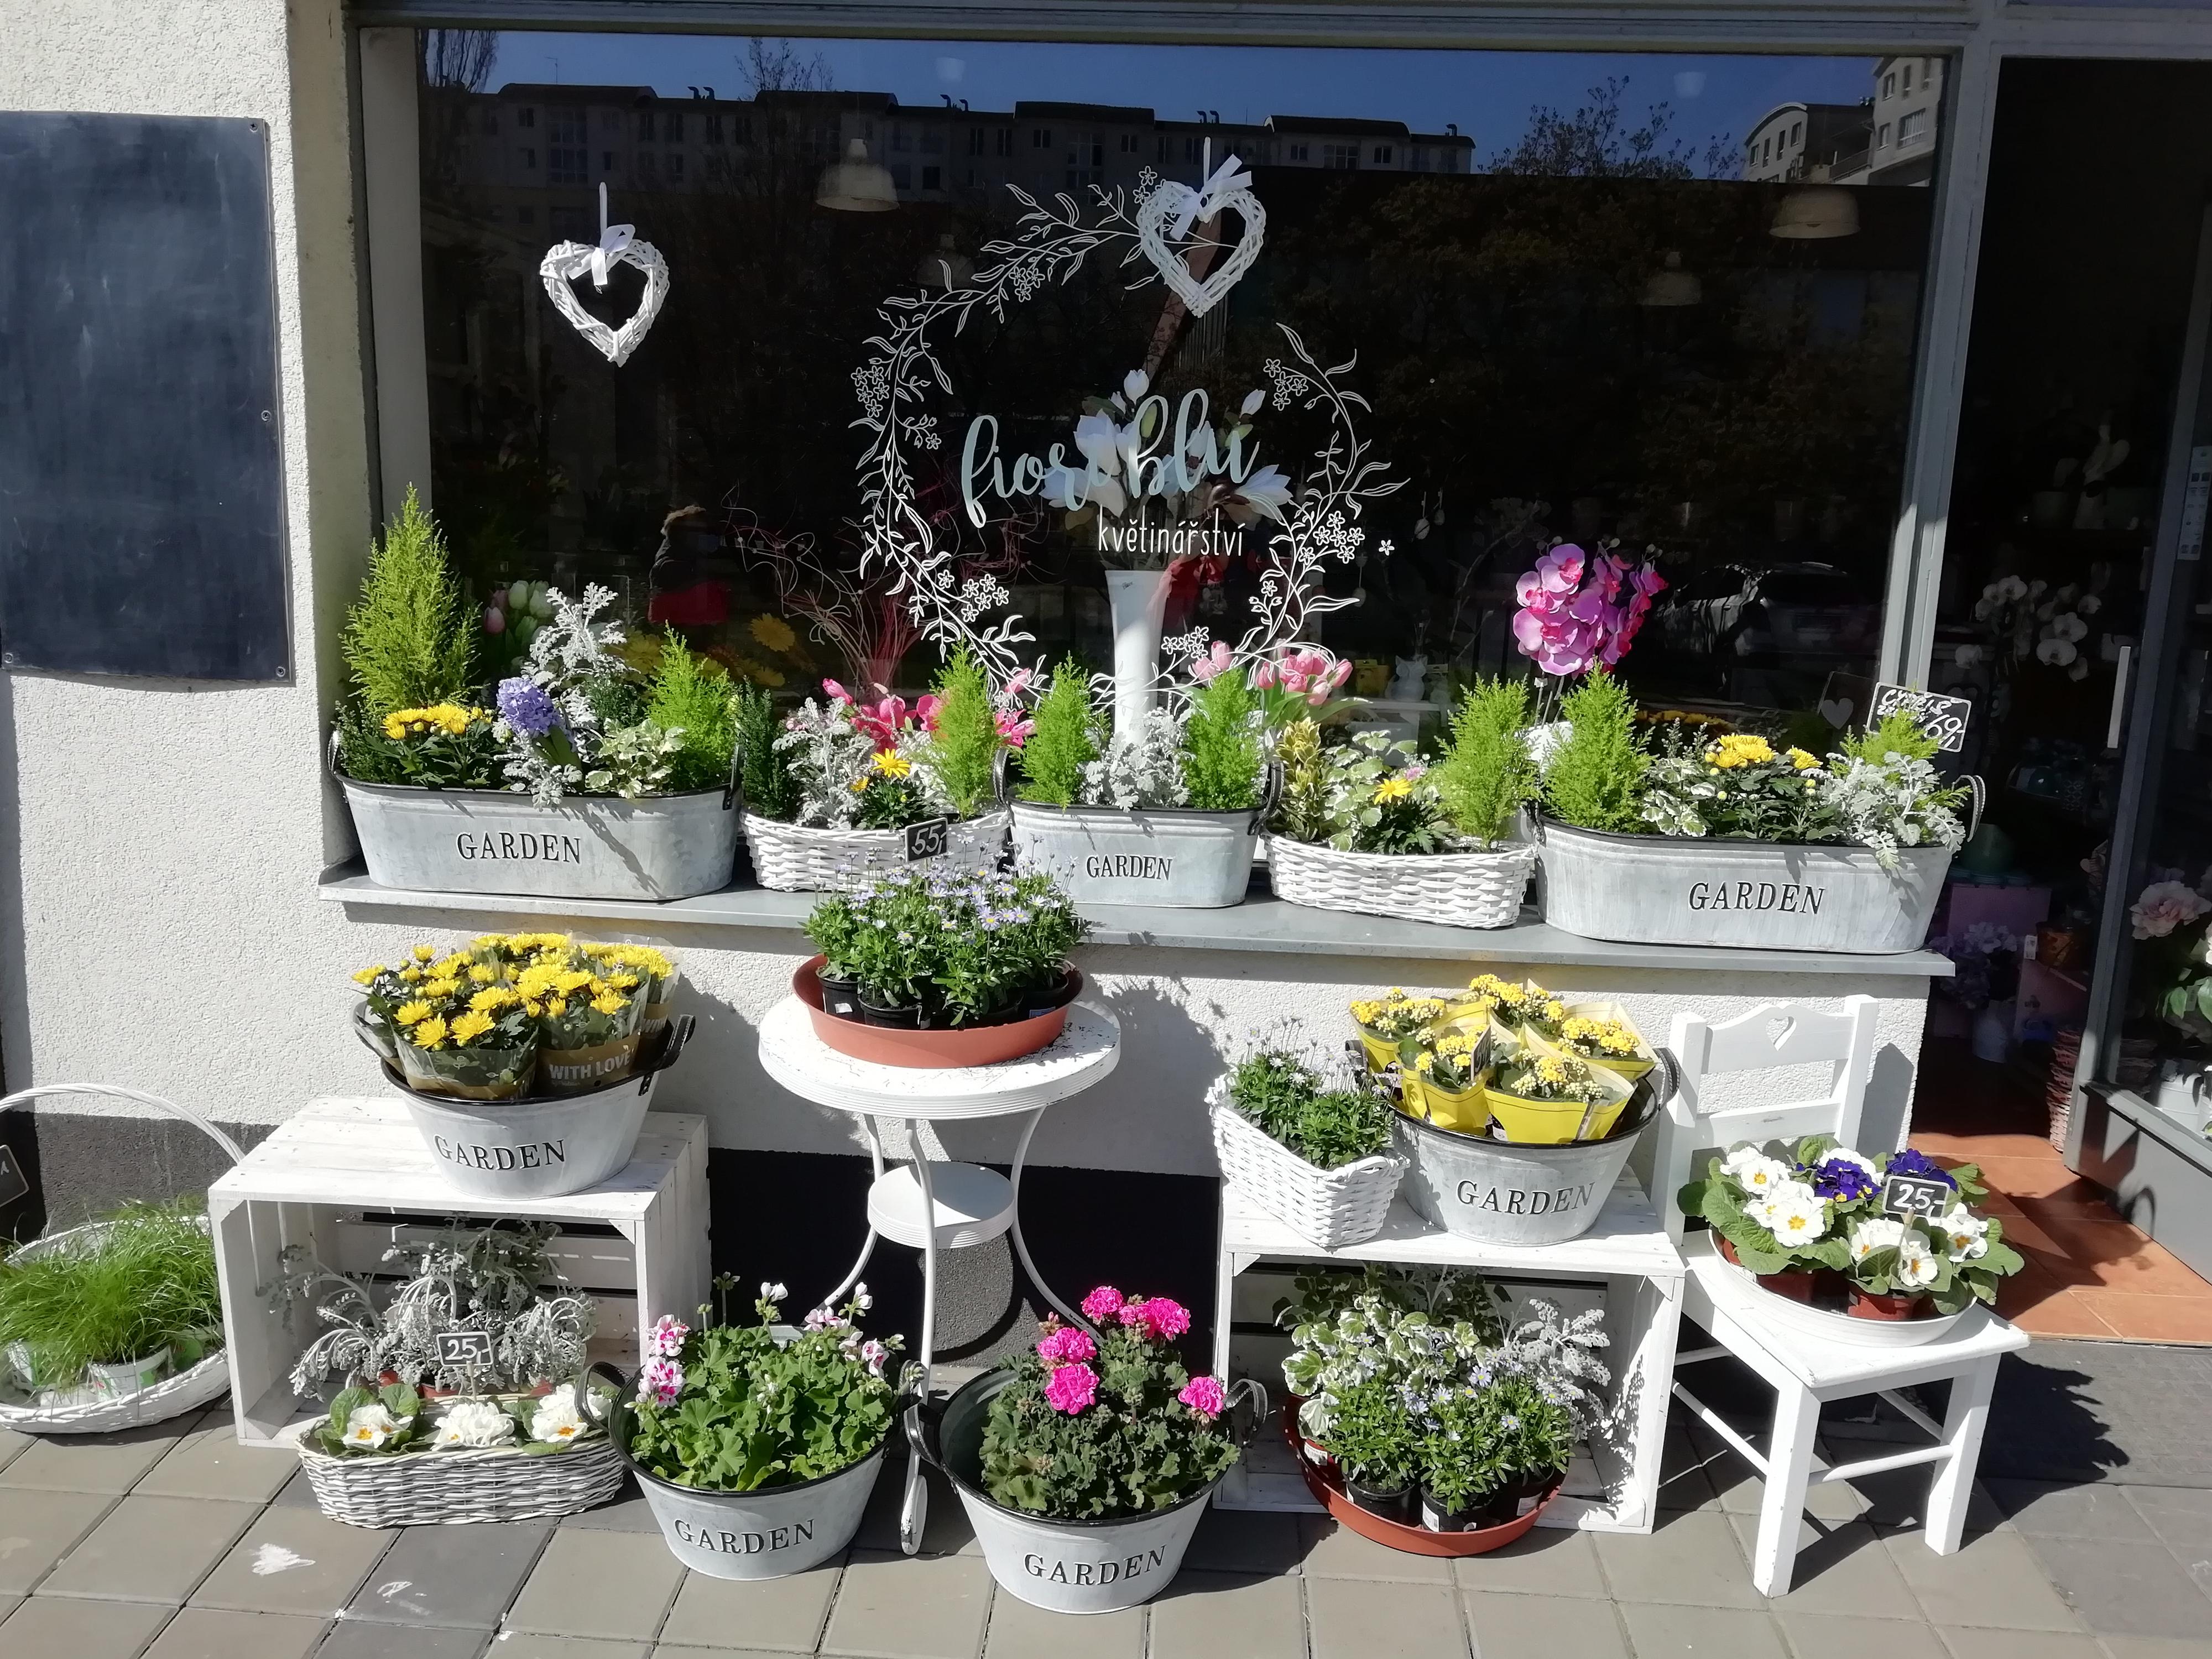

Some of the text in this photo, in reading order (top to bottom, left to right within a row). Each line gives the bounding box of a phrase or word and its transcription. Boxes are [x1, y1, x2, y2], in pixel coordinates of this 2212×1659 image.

[961, 388, 1260, 528] fiori blu
[1098, 504, 1245, 556] květinářství
[457, 832, 582, 864] GARDEN
[911, 824, 947, 855] 55,-
[1086, 855, 1173, 880] GARDEN
[1689, 881, 1825, 914] GARDEN
[549, 1050, 630, 1080] WITH LOVE
[434, 1135, 565, 1171] GARDEN
[1457, 1180, 1596, 1215] GARDEN
[1893, 1183, 1946, 1217] 25,-
[445, 1338, 490, 1364] 25,-
[674, 1519, 815, 1554] GARDEN
[1024, 1544, 1167, 1586] GARDEN
